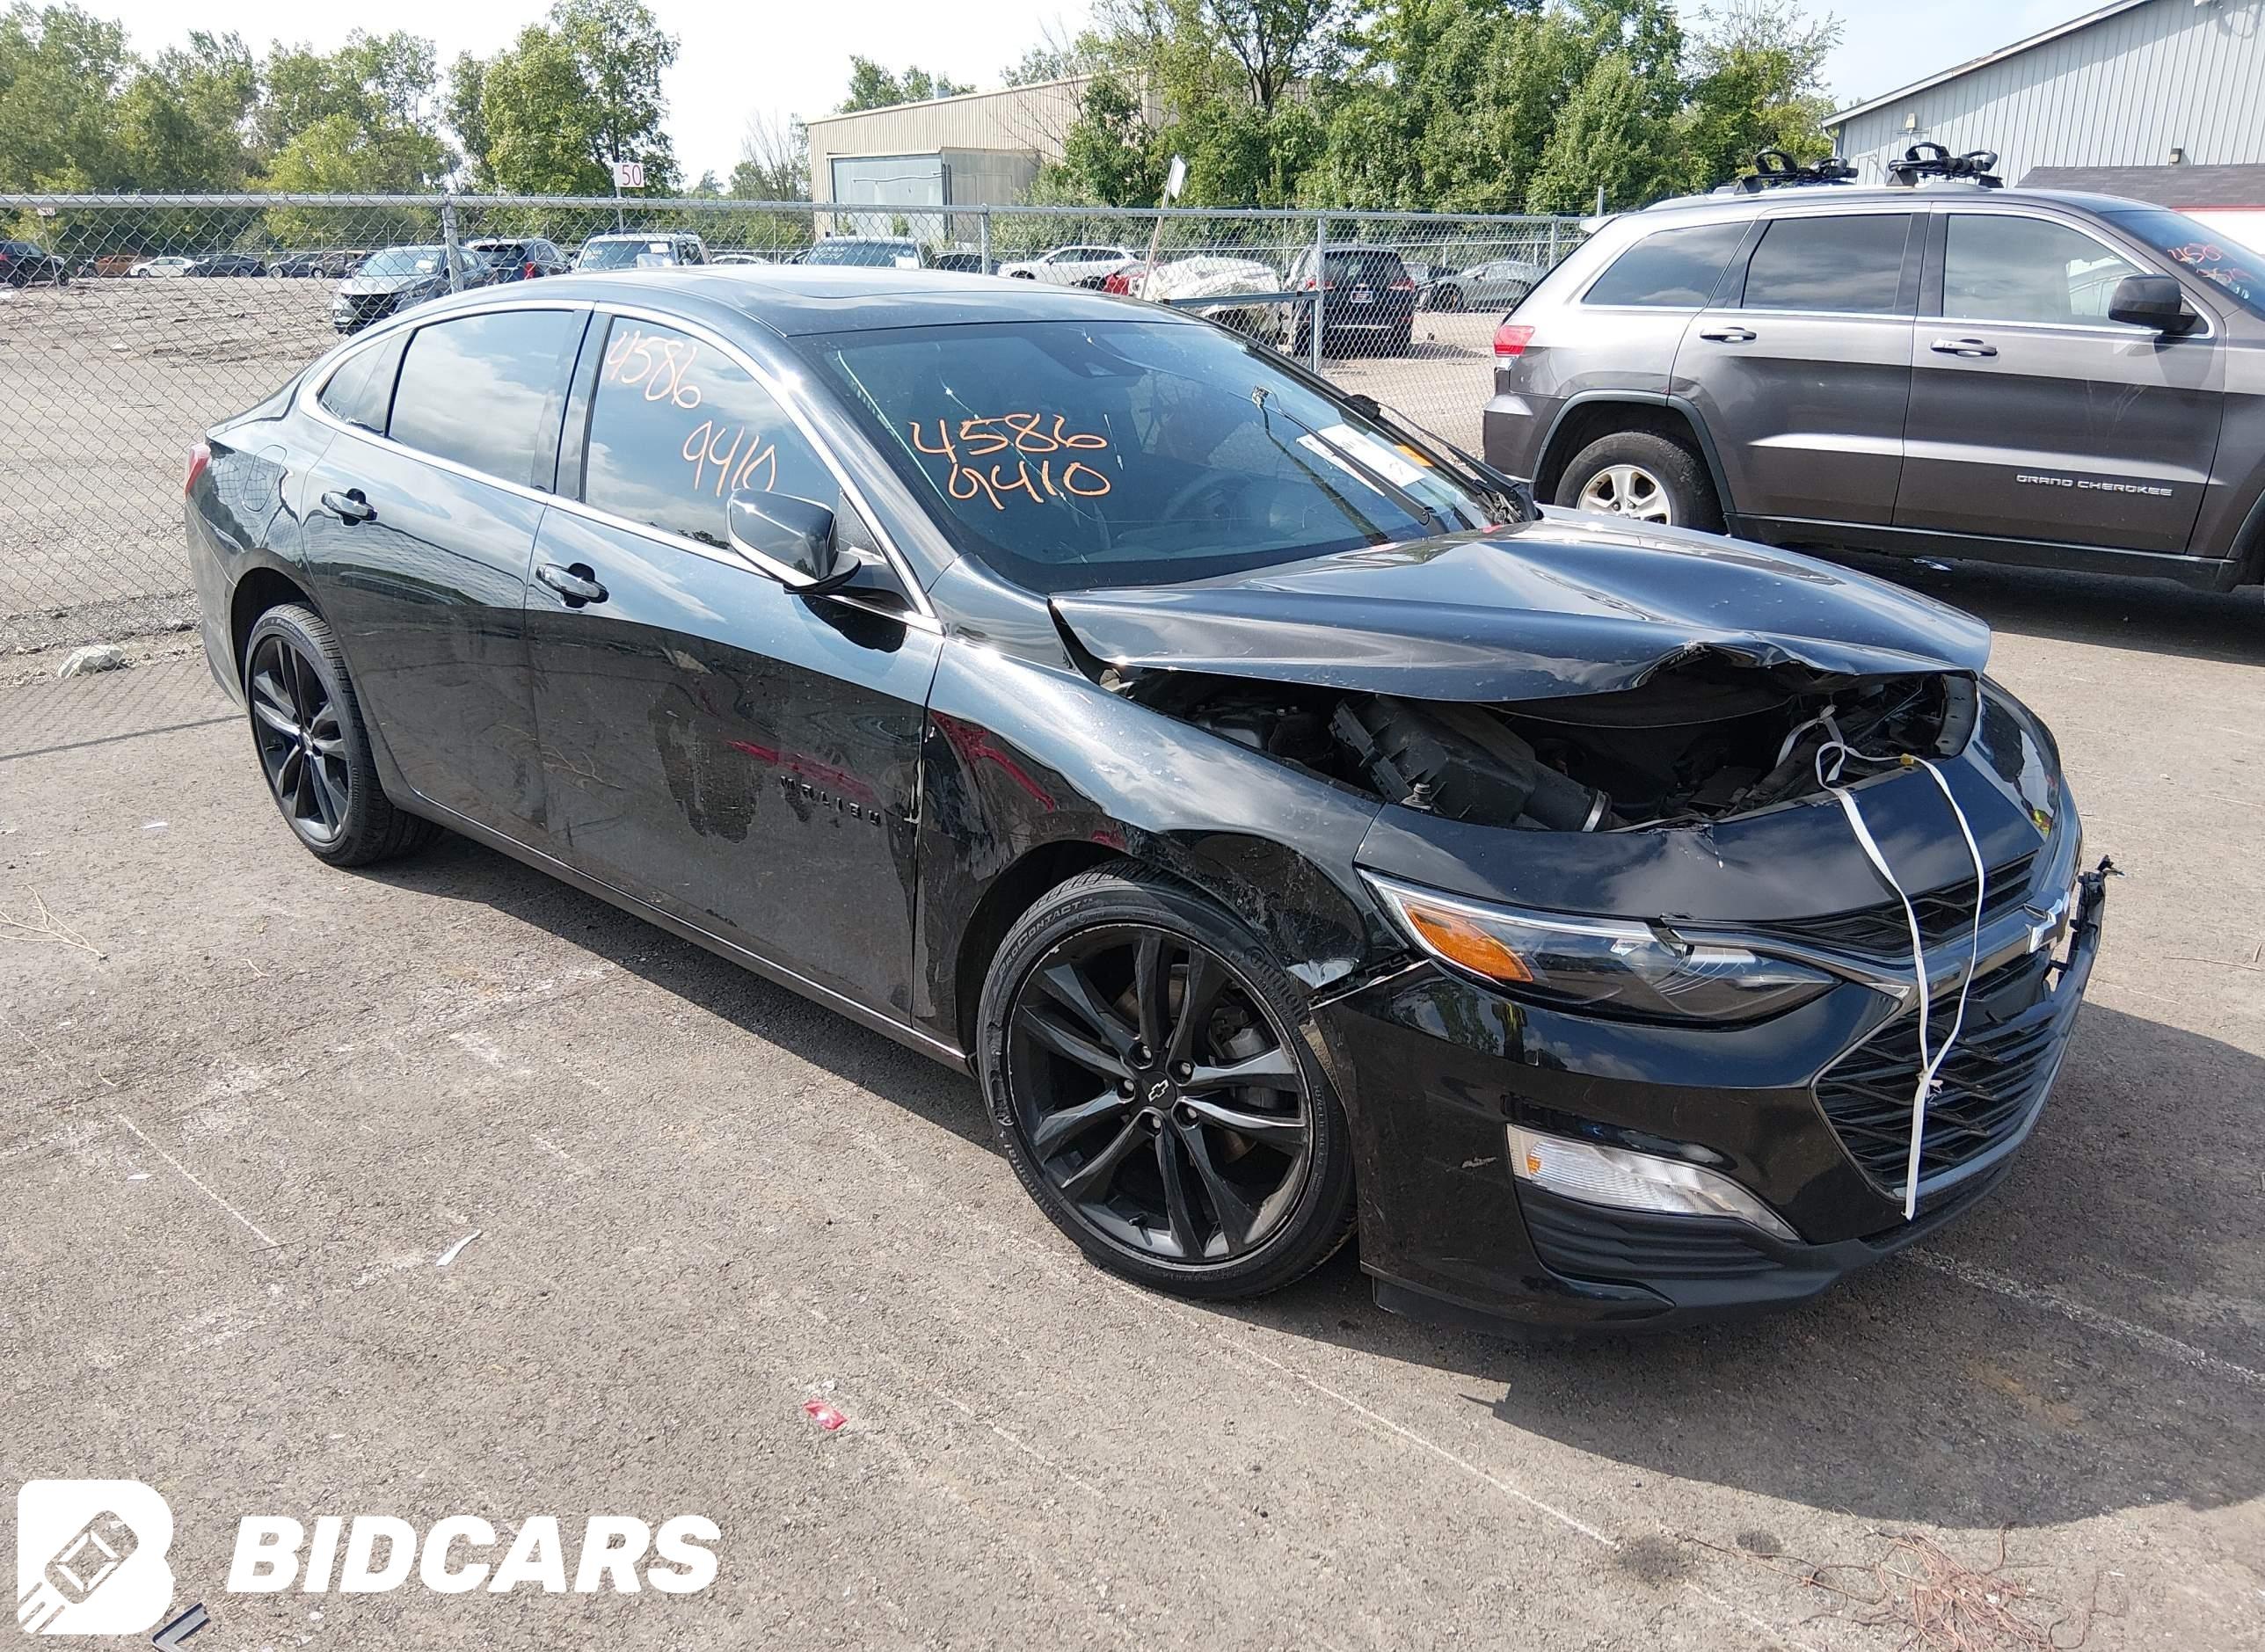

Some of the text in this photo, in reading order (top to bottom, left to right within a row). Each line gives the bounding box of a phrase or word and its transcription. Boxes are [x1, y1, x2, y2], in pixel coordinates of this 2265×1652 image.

[622, 164, 642, 186] 50
[606, 331, 703, 409] 4586
[682, 420, 776, 498] 9410
[907, 413, 1108, 465] 4586
[948, 459, 1112, 510] 9410
[2015, 474, 2174, 497] GRAND CHEROKEE
